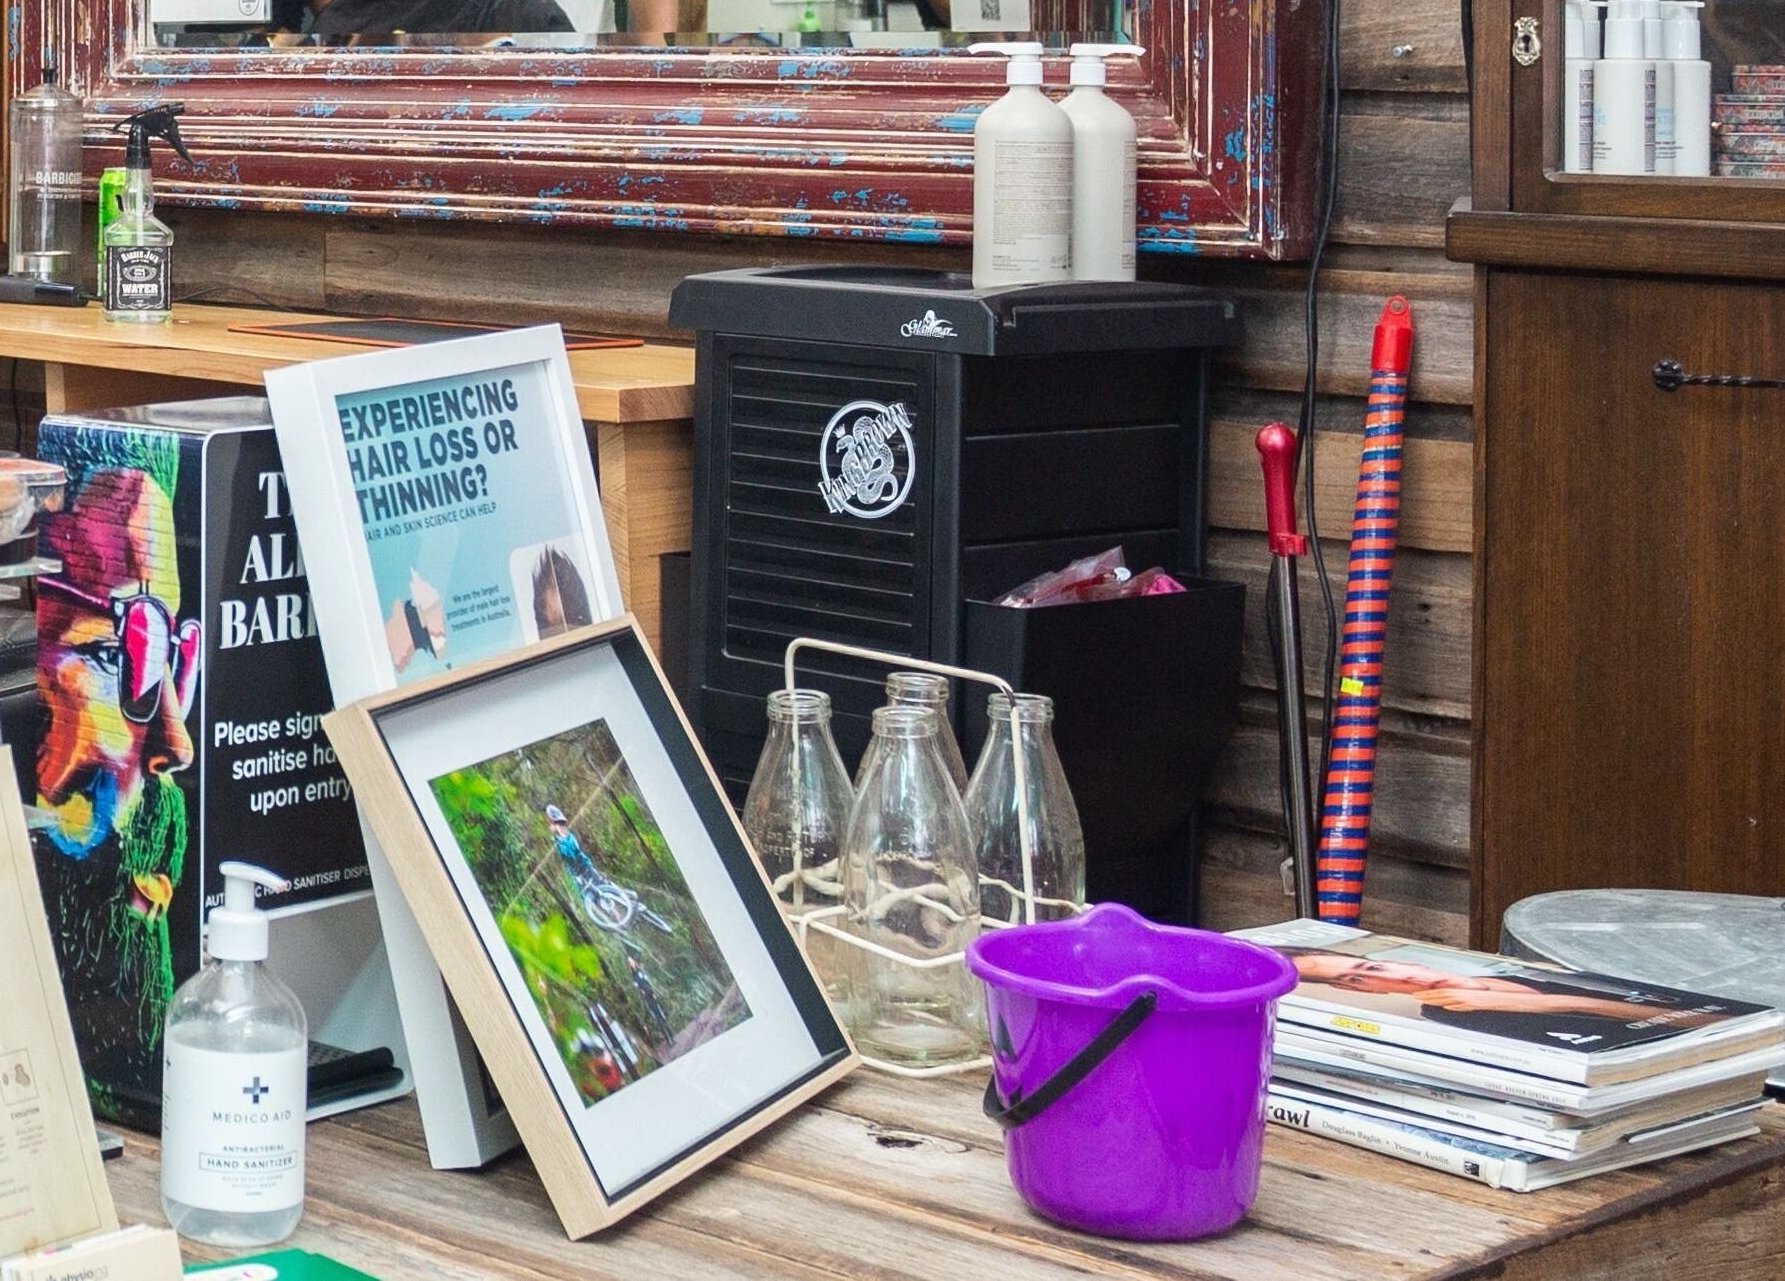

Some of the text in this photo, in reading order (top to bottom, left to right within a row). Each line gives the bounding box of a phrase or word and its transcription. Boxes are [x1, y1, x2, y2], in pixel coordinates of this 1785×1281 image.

[121, 283, 159, 295] WATER
[339, 379, 520, 444] EXPERIENCING
[348, 419, 519, 485] HAIR LOSS OR
[355, 462, 490, 525] THINNING?
[383, 501, 498, 538] AND SKIN SCIENCE CAN HELP
[213, 713, 282, 748] Please
[232, 746, 308, 780] sanitise
[249, 772, 352, 815] upon entry
[293, 870, 342, 890] SANITISER
[212, 1110, 292, 1124] MEDICO AID
[207, 1156, 293, 1169] HAND SANITIZER
